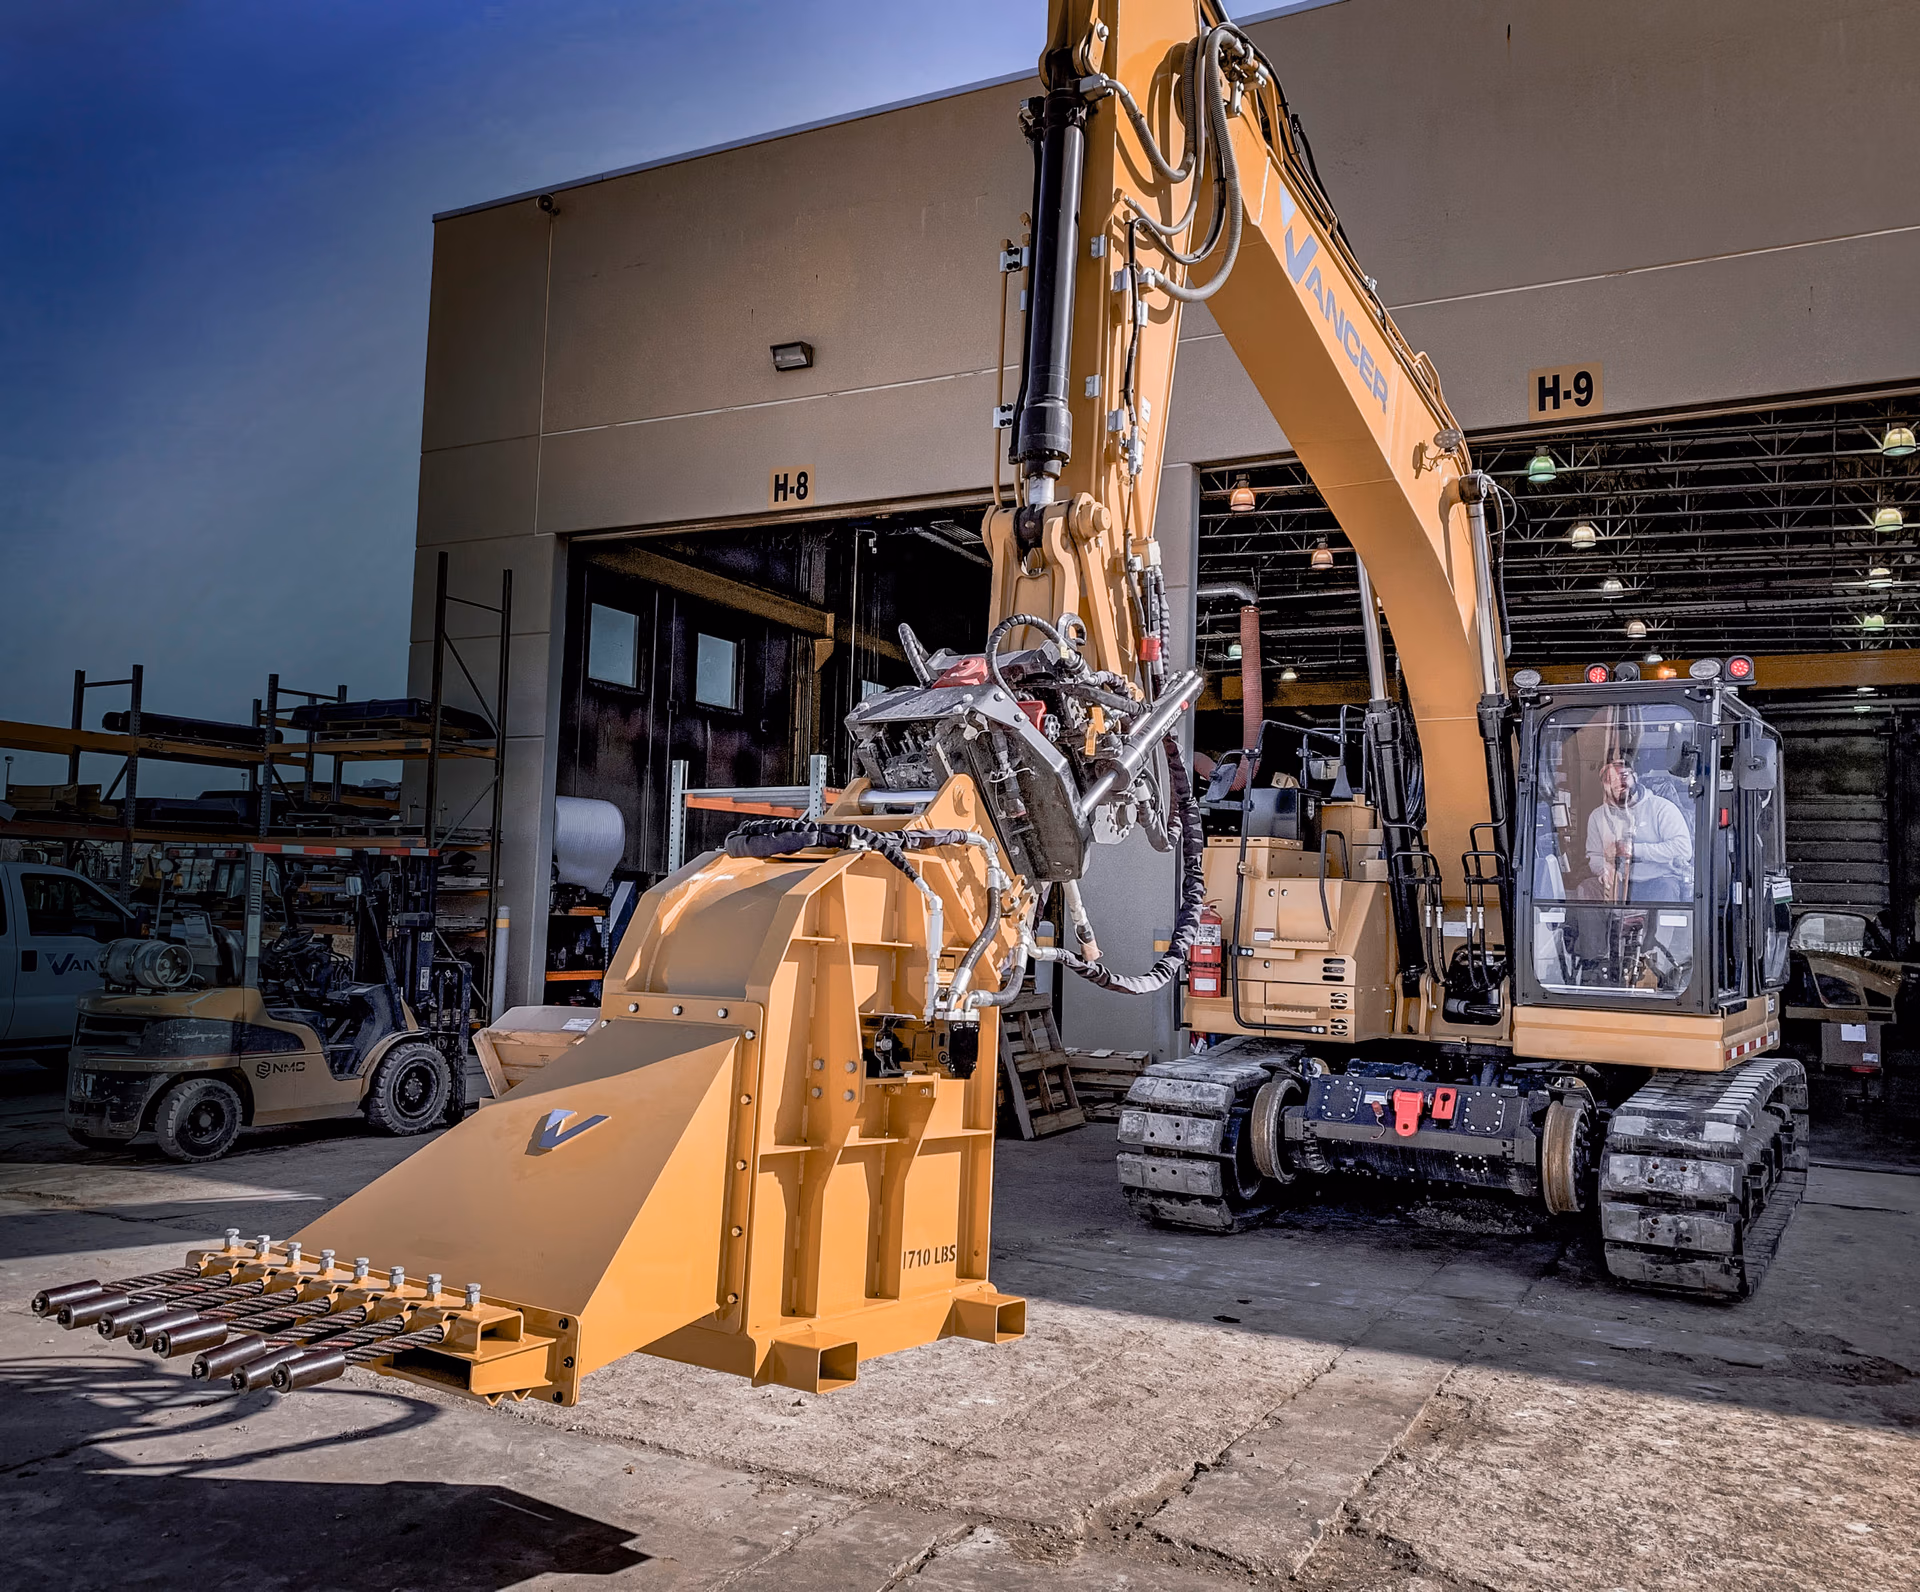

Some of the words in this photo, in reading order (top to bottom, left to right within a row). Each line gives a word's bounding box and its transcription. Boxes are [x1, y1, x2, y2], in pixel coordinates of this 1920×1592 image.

[1279, 182, 1389, 415] VANCER
[1537, 370, 1594, 412] H-9
[773, 471, 809, 503] H-8
[421, 932, 433, 941] CAT
[934, 1244, 956, 1264] LBS
